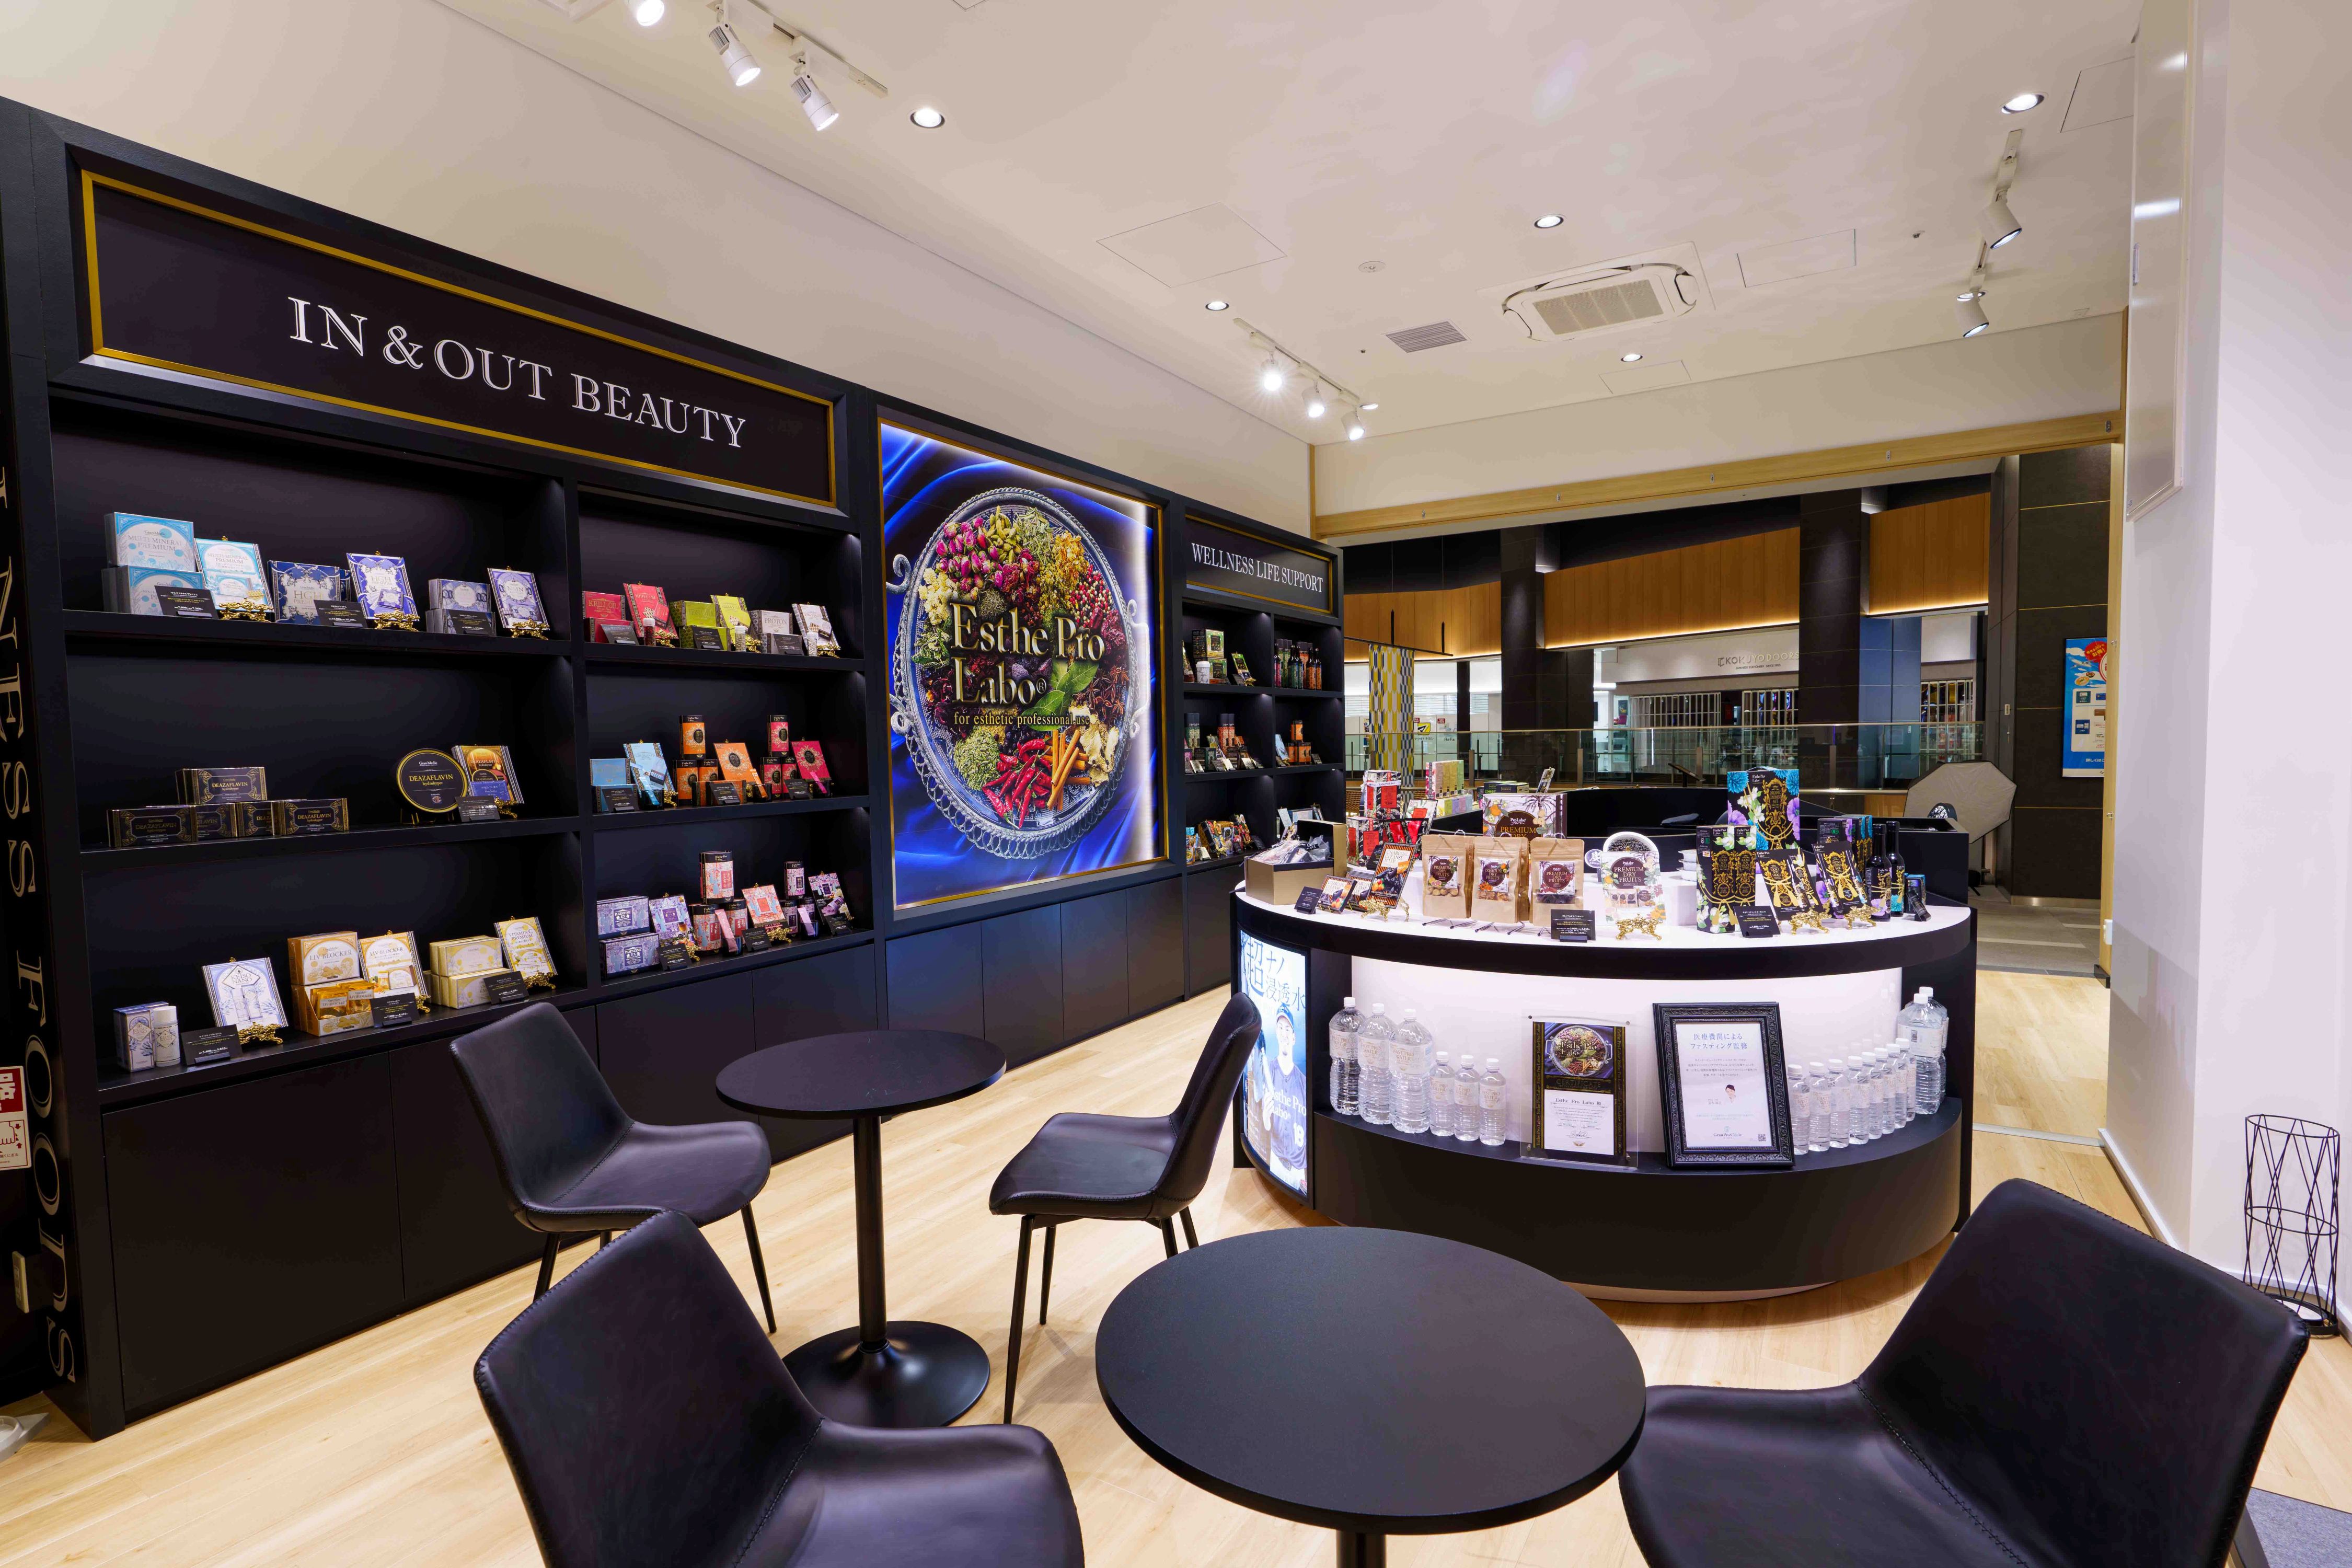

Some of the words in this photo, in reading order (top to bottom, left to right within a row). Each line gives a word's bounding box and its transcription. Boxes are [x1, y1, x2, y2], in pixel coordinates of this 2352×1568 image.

[288, 297, 367, 356] IN
[383, 325, 423, 370] &
[433, 339, 552, 400] OUT
[571, 373, 746, 448] BEAUTY
[137, 542, 176, 551] PREMIUM
[1191, 543, 1254, 575] WELLNESS
[1256, 560, 1280, 582] LIFE
[1282, 567, 1323, 593] SUPPORT
[294, 590, 322, 599] HGH
[765, 617, 787, 625] PROTON
[950, 602, 1048, 656] Esthe
[1055, 616, 1105, 661] Pro
[954, 712, 970, 724] for
[974, 712, 1013, 725] esthetic
[1017, 712, 1073, 728] professional
[1076, 715, 1090, 725] use
[409, 774, 454, 782] DEAZAFLAVIN
[1247, 937, 1264, 997] 超
[1266, 950, 1285, 975] ナノ
[1266, 975, 1306, 1011] 浸透水
[1556, 1079, 1600, 1088] CERTIFICATE
[1292, 1096, 1307, 1116] Pro
[1293, 1122, 1305, 1148] 18
